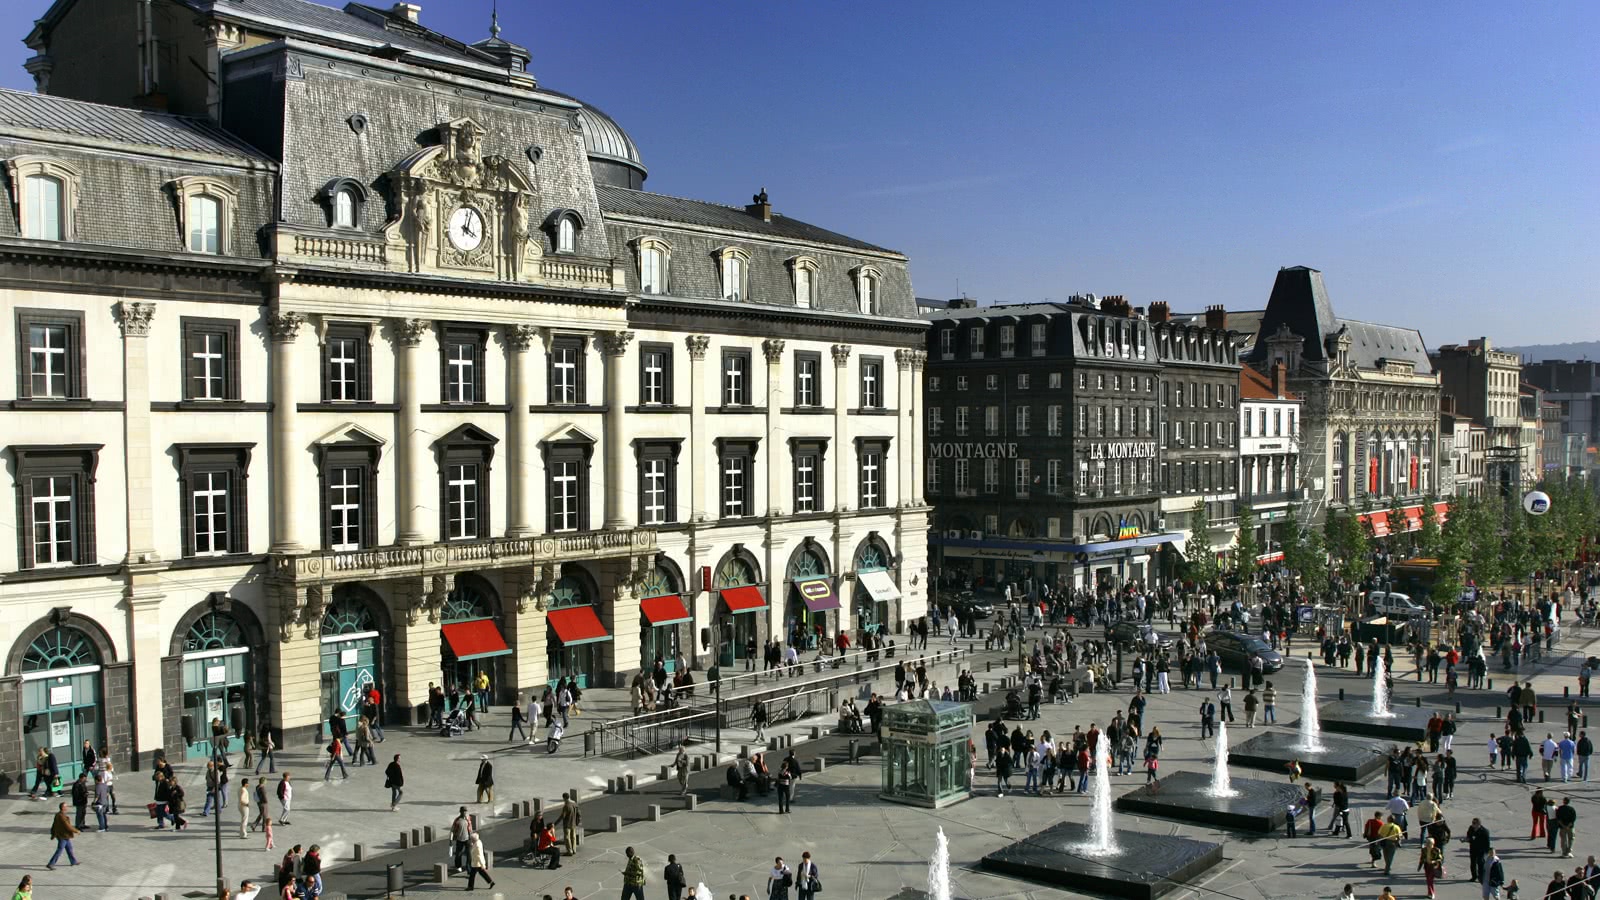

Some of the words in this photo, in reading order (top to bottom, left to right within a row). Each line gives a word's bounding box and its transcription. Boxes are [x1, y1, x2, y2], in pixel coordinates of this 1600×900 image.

[929, 442, 1018, 458] MONTAGNE
[1090, 443, 1103, 459] LA
[1108, 442, 1156, 458] MONTAGNE
